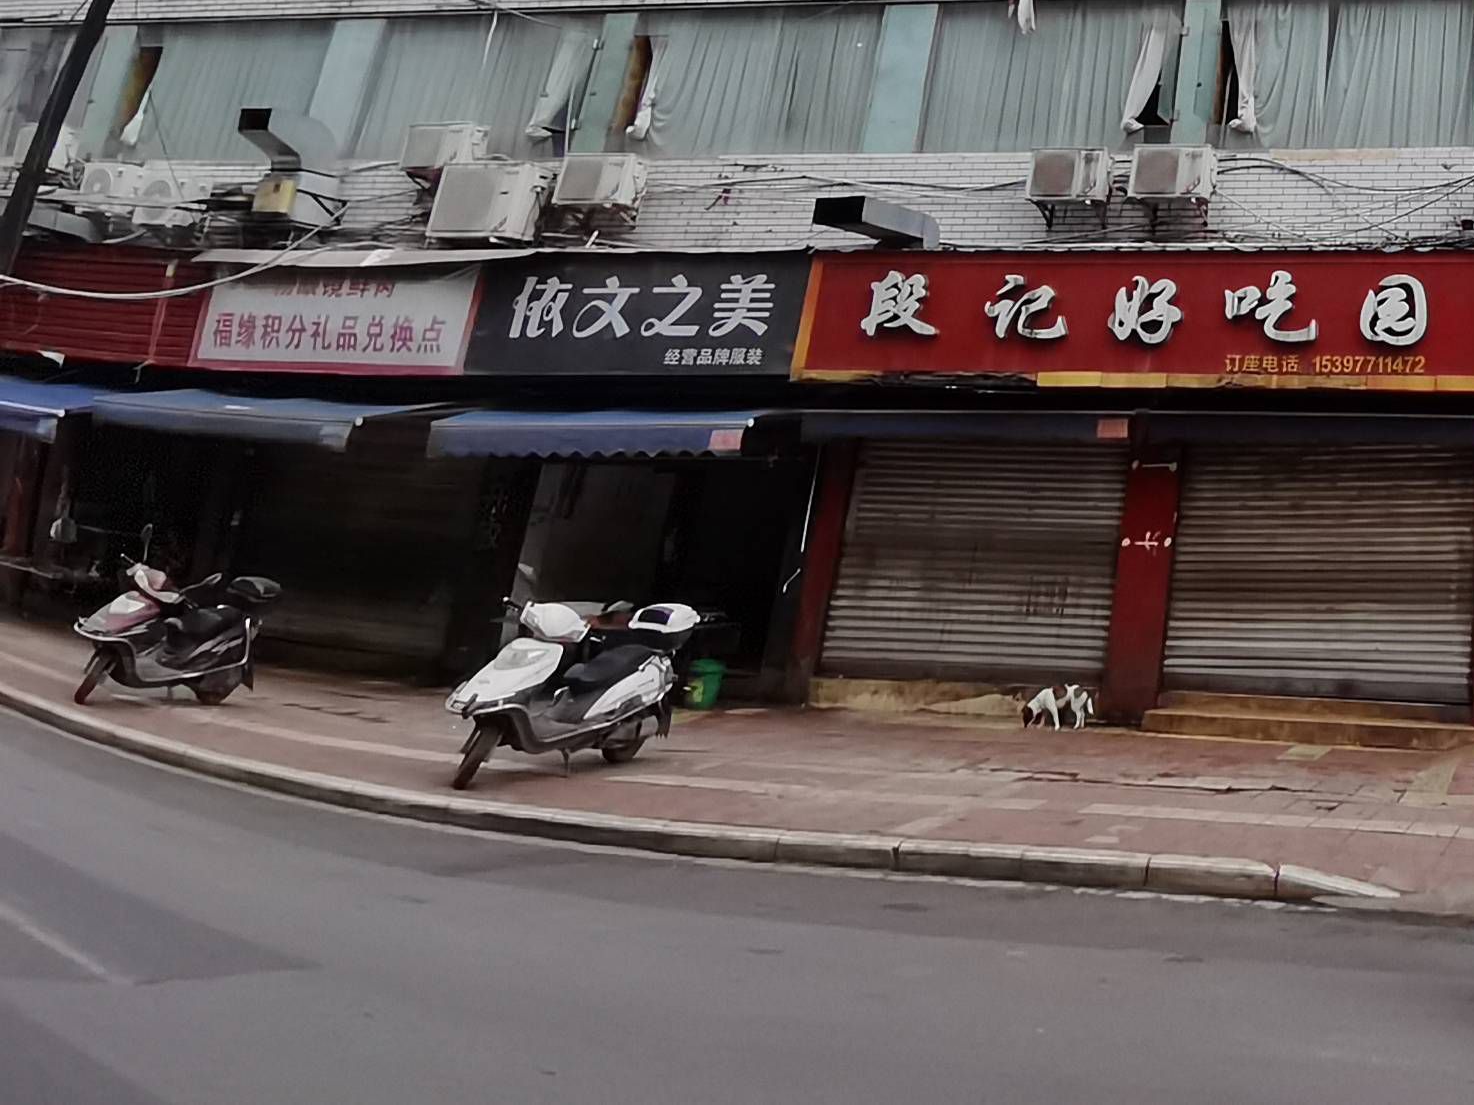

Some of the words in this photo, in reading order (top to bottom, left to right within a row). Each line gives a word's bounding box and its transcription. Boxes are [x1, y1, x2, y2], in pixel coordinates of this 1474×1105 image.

[509, 274, 776, 339] 依文之美
[860, 270, 1428, 346] 段记好吃园
[212, 312, 447, 353] 福缘积分礼品兑换点
[663, 347, 763, 366] 经营品牌服装
[1225, 354, 1299, 372] 订座电话
[1312, 355, 1426, 374] 15397711472
